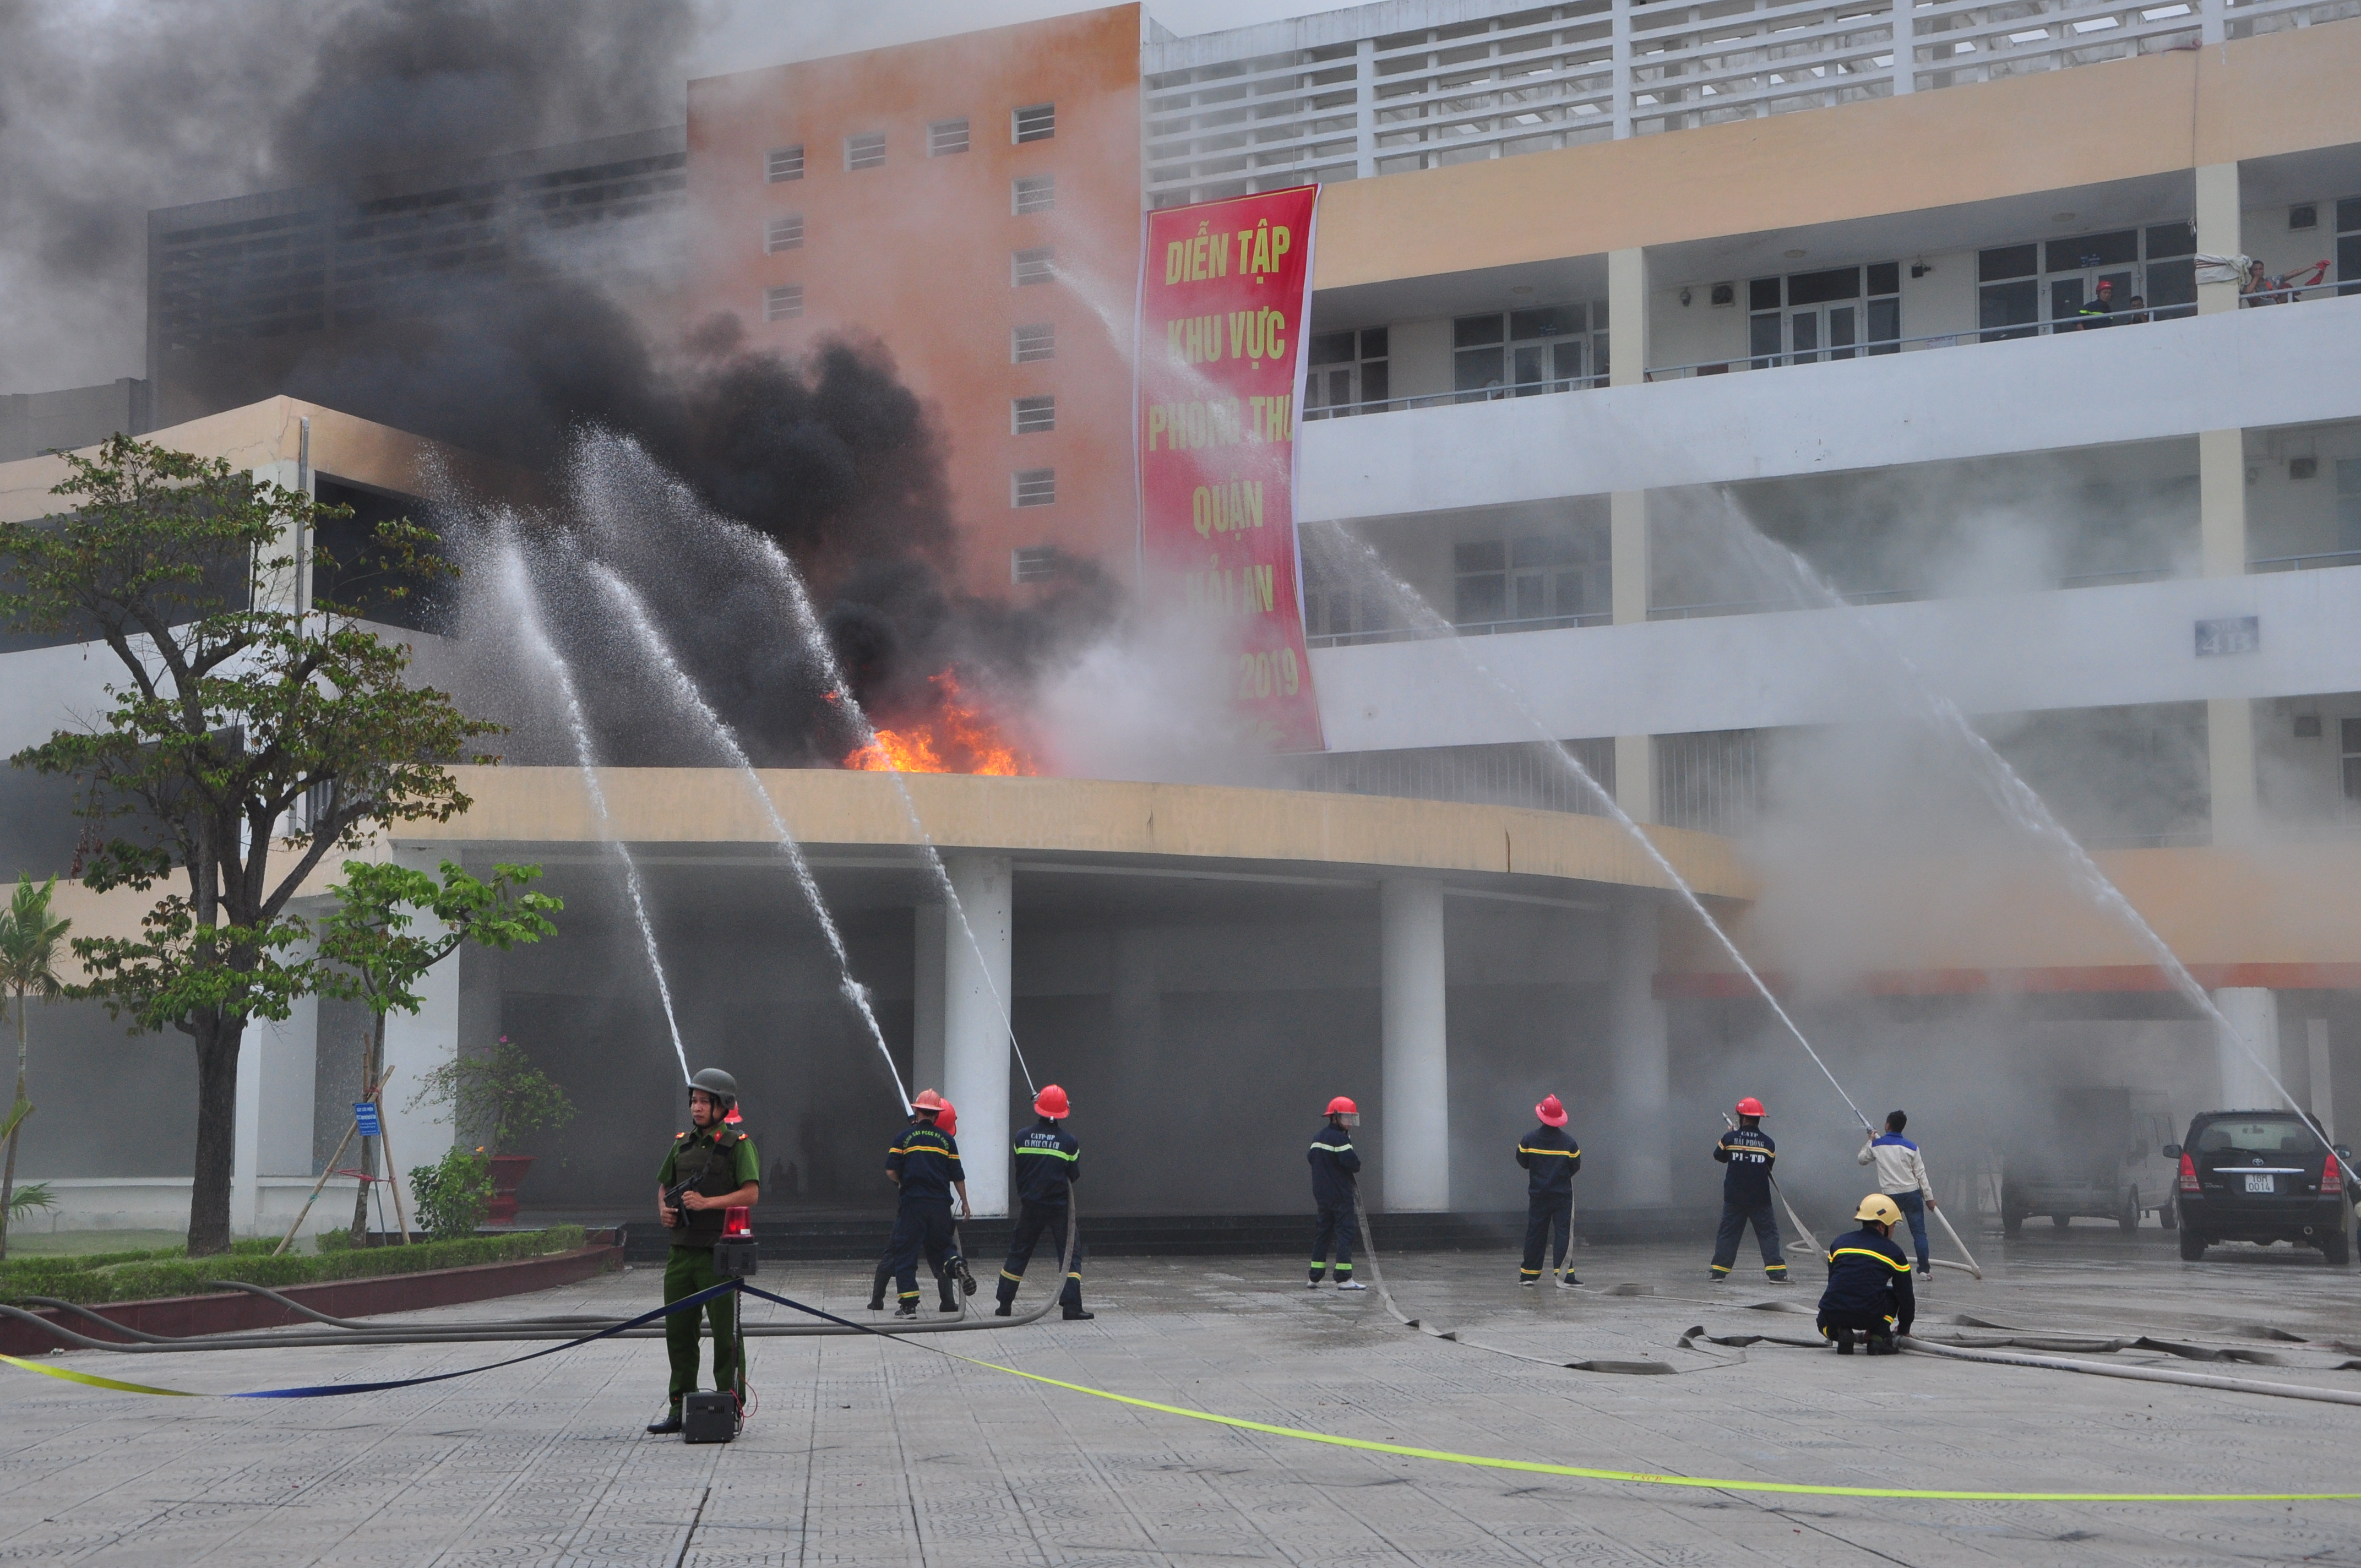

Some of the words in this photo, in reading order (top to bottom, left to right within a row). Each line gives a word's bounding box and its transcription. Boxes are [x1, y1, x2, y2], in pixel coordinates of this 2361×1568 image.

[1165, 220, 1229, 286] DIỄN
[1237, 218, 1291, 284] TẬP
[1167, 314, 1222, 364] KHU
[1228, 306, 1285, 370] VỰC
[1149, 388, 1241, 451] PHÒNG
[1193, 471, 1264, 541] QUẬN
[1242, 564, 1274, 615] AN
[1240, 647, 1299, 699] 2019
[1734, 1136, 1744, 1145] HẢI
[1745, 1138, 1765, 1147] PHÒNG
[2249, 1183, 2270, 1191] 0014
